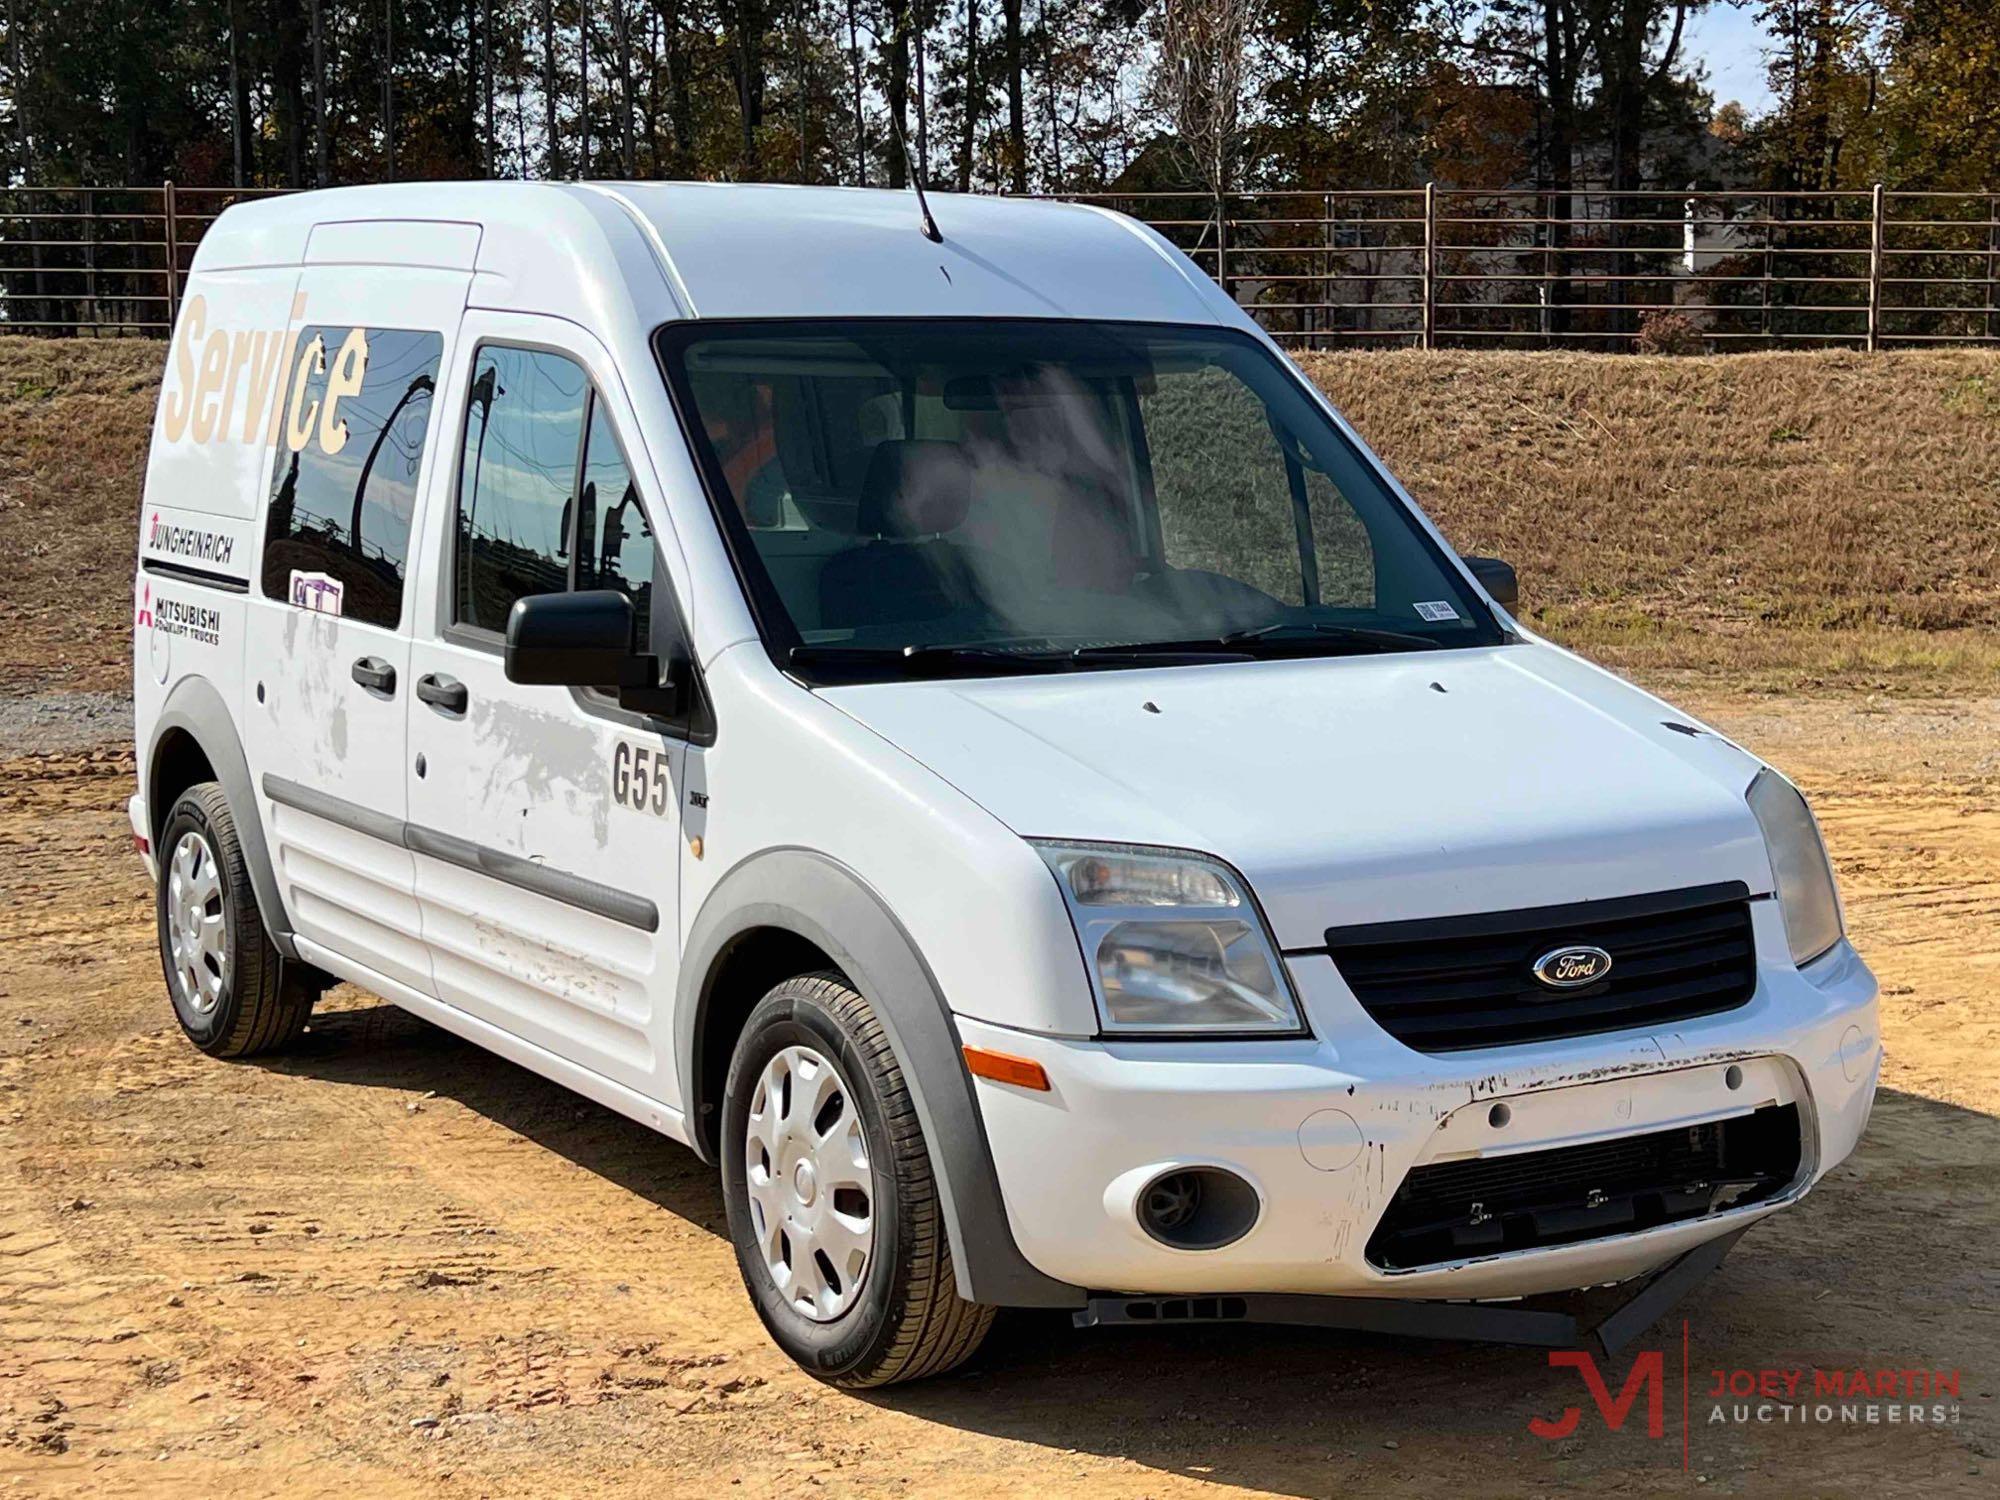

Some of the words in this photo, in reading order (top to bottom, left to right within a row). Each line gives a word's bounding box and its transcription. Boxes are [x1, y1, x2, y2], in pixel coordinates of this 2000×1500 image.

[163, 291, 369, 455] Service
[149, 513, 234, 564] JUNGHEINRICH
[156, 598, 220, 632] MITSUBISHI
[190, 627, 219, 646] TRUCKS
[613, 741, 669, 817] G55
[1556, 955, 1596, 979] Ford
